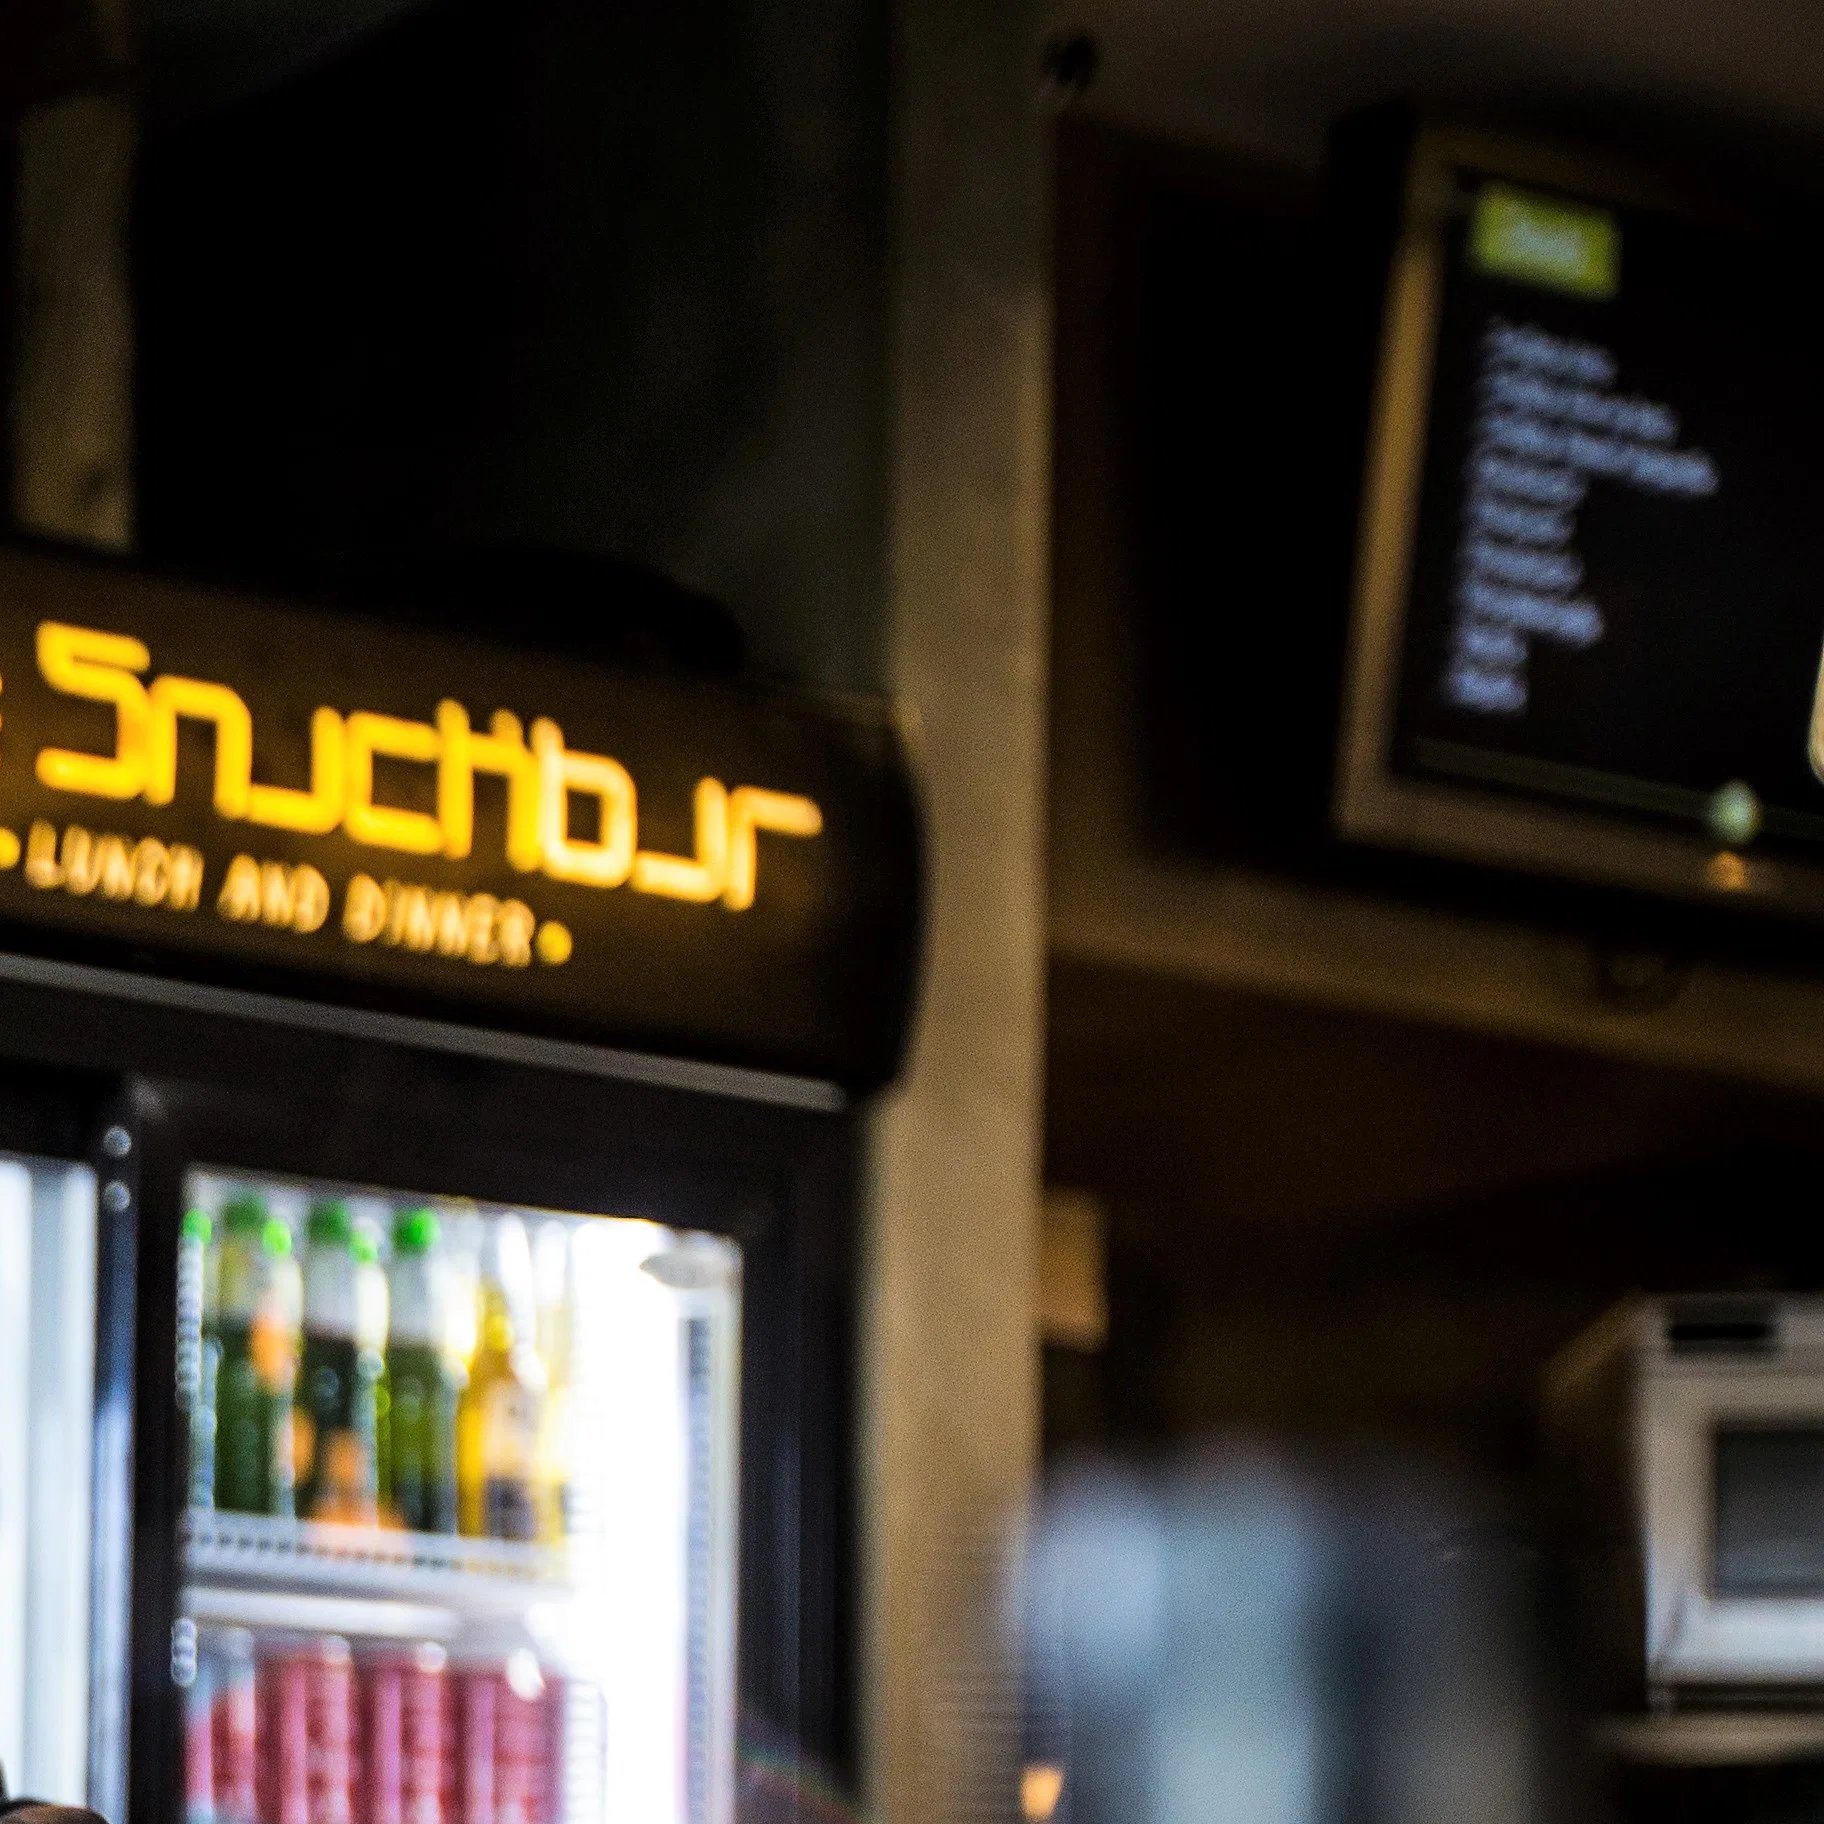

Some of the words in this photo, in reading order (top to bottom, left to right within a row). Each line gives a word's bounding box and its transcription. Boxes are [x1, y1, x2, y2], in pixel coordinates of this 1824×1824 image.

[22, 818, 204, 912] LUNCH
[217, 852, 330, 935] AND
[342, 872, 537, 968] DINNER
